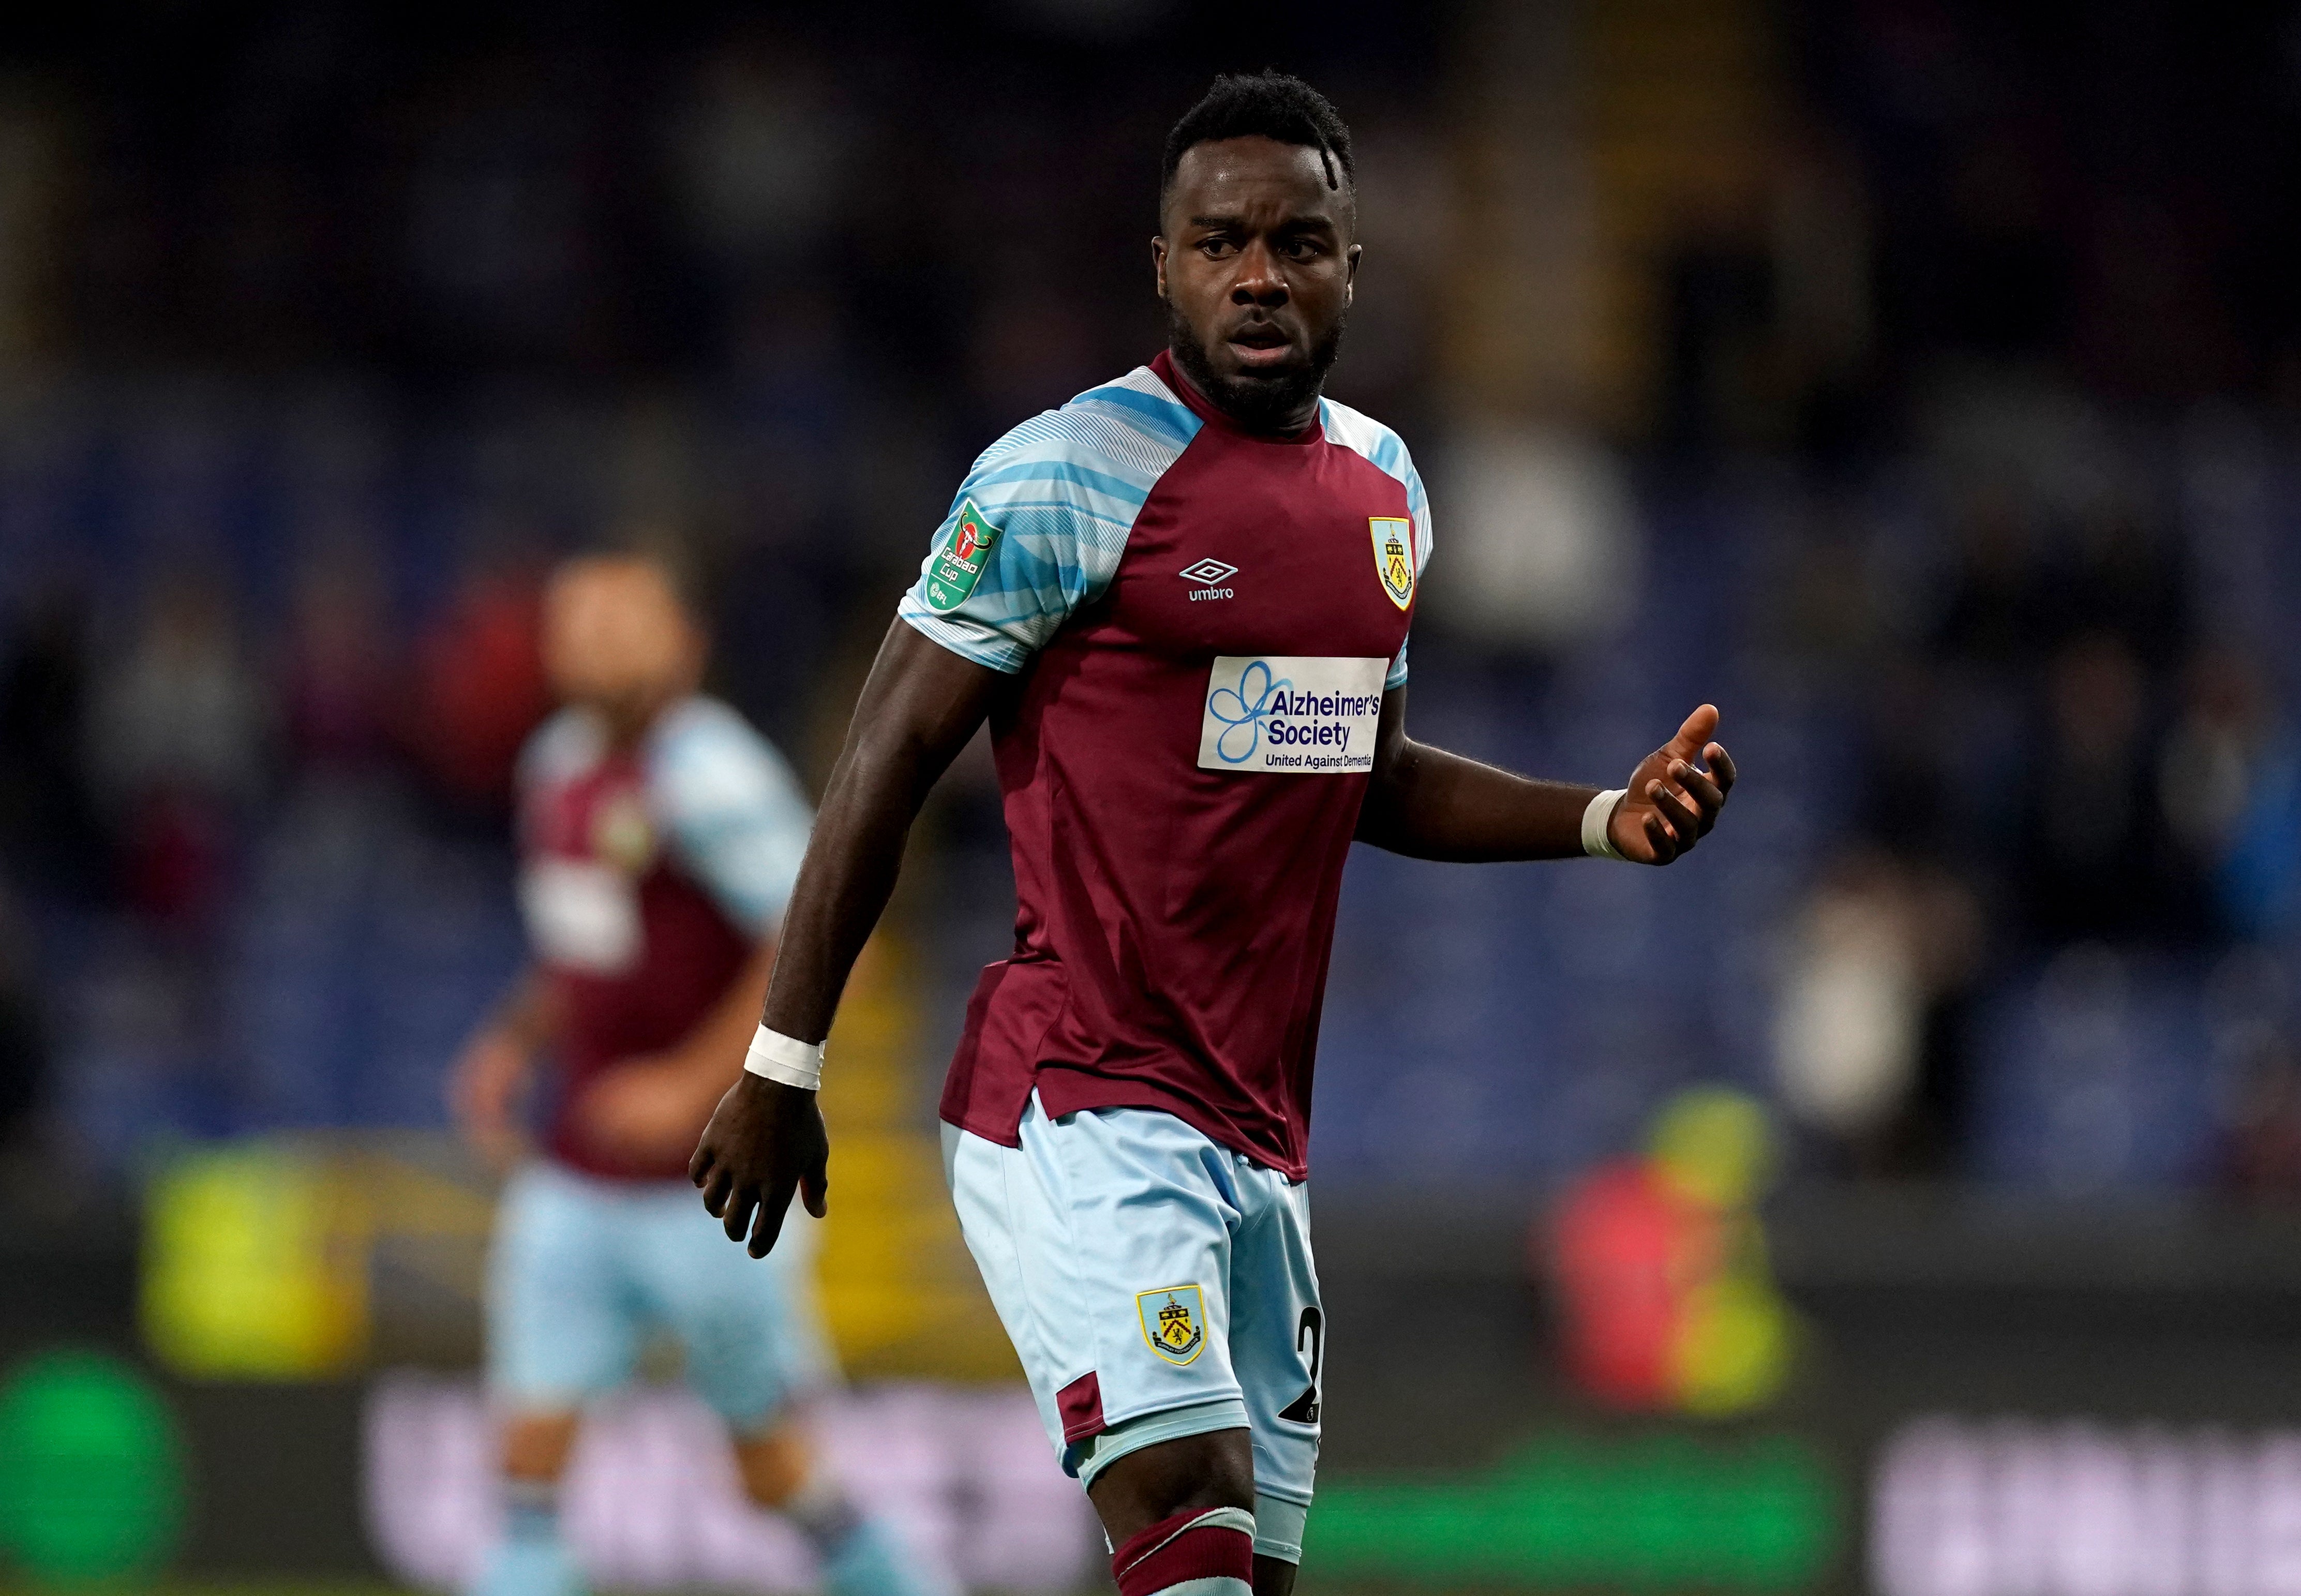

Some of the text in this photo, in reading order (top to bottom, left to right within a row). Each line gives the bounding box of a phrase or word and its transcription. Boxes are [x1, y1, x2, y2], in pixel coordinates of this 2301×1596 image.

[941, 546, 978, 574] Carabao
[939, 563, 959, 582] Cup
[937, 590, 947, 605] EFL
[1189, 587, 1234, 602] umbro
[1269, 690, 1379, 716] Alzheimer's
[1268, 720, 1350, 752] Society
[1266, 754, 1371, 770] United Against Dementia
[1277, 1306, 1321, 1424] 2
